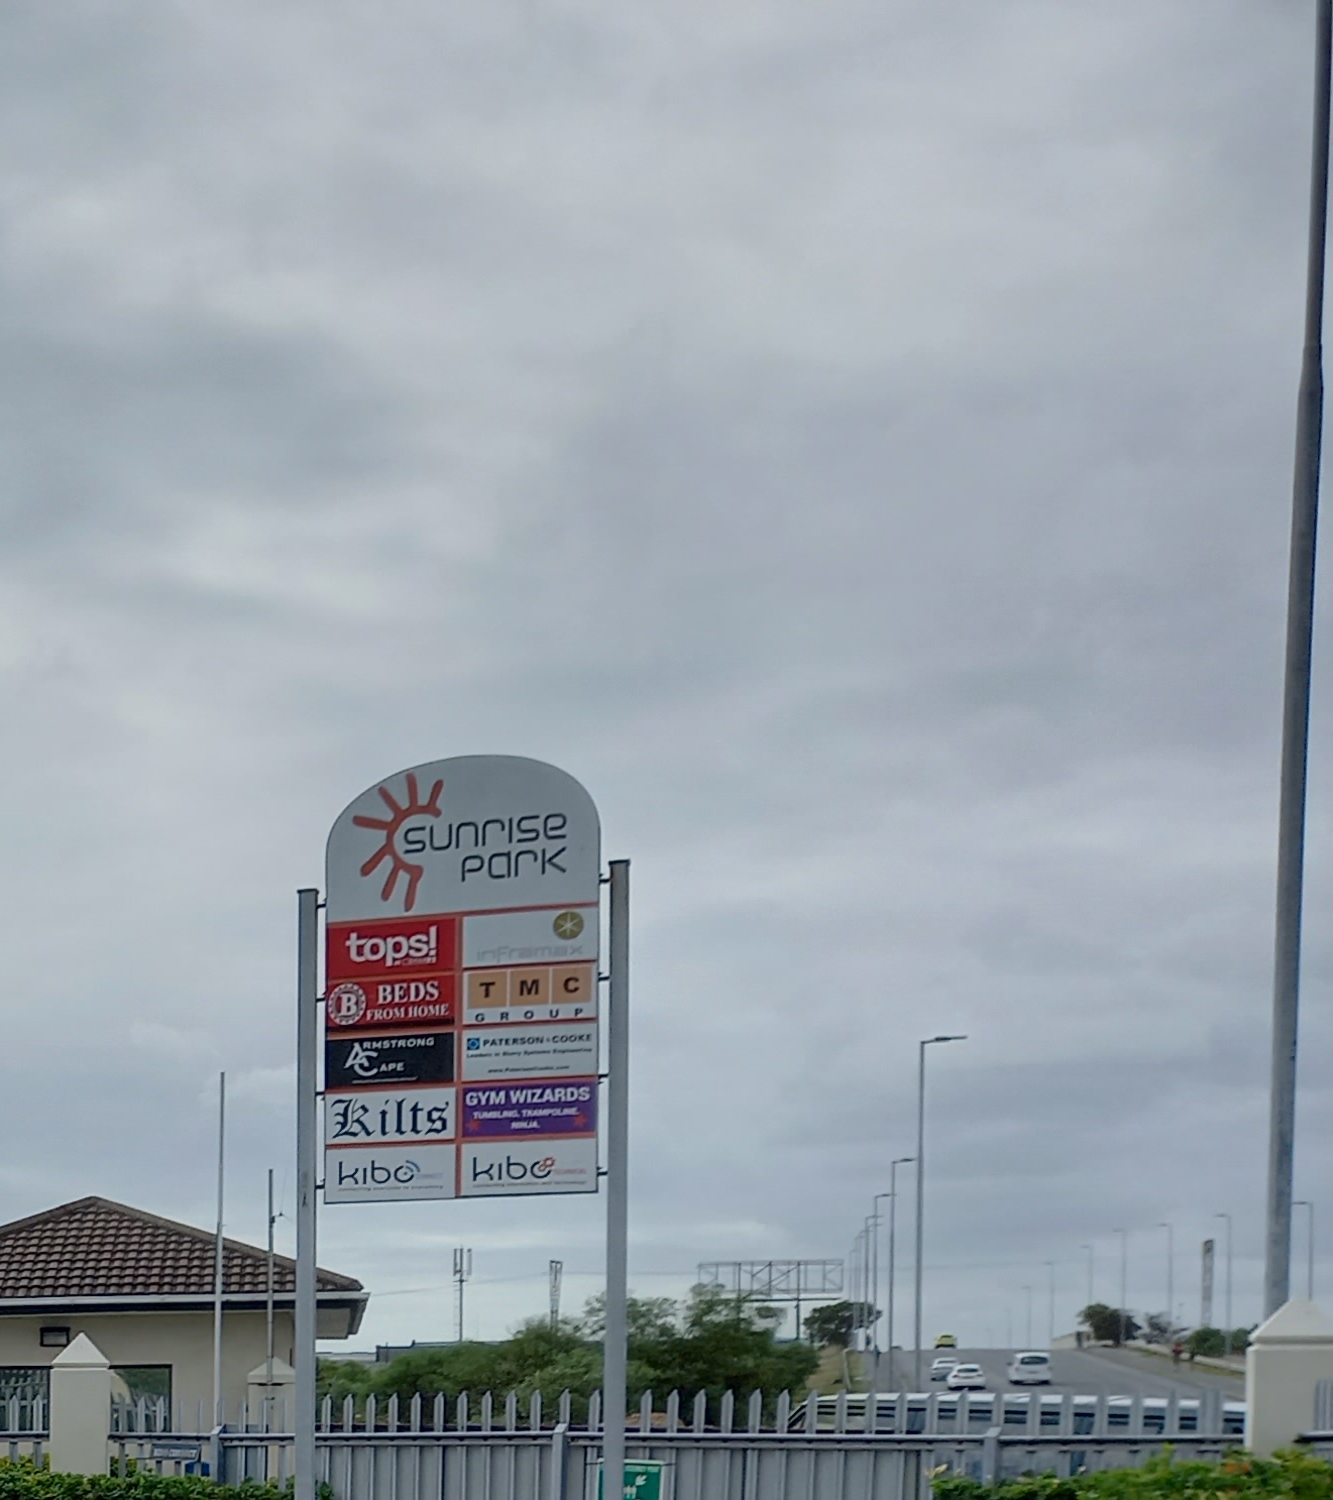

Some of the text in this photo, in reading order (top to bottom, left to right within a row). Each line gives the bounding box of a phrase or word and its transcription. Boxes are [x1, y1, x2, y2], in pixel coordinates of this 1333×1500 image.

[377, 980, 441, 1005] BEDS
[366, 1003, 450, 1021] FROM HOME
[475, 1007, 584, 1022] GROUP
[483, 1036, 544, 1047] PATERSON
[552, 1033, 593, 1044] COOKE
[465, 1086, 591, 1107] GYM WIZARDS
[330, 1098, 450, 1138] Kilts
